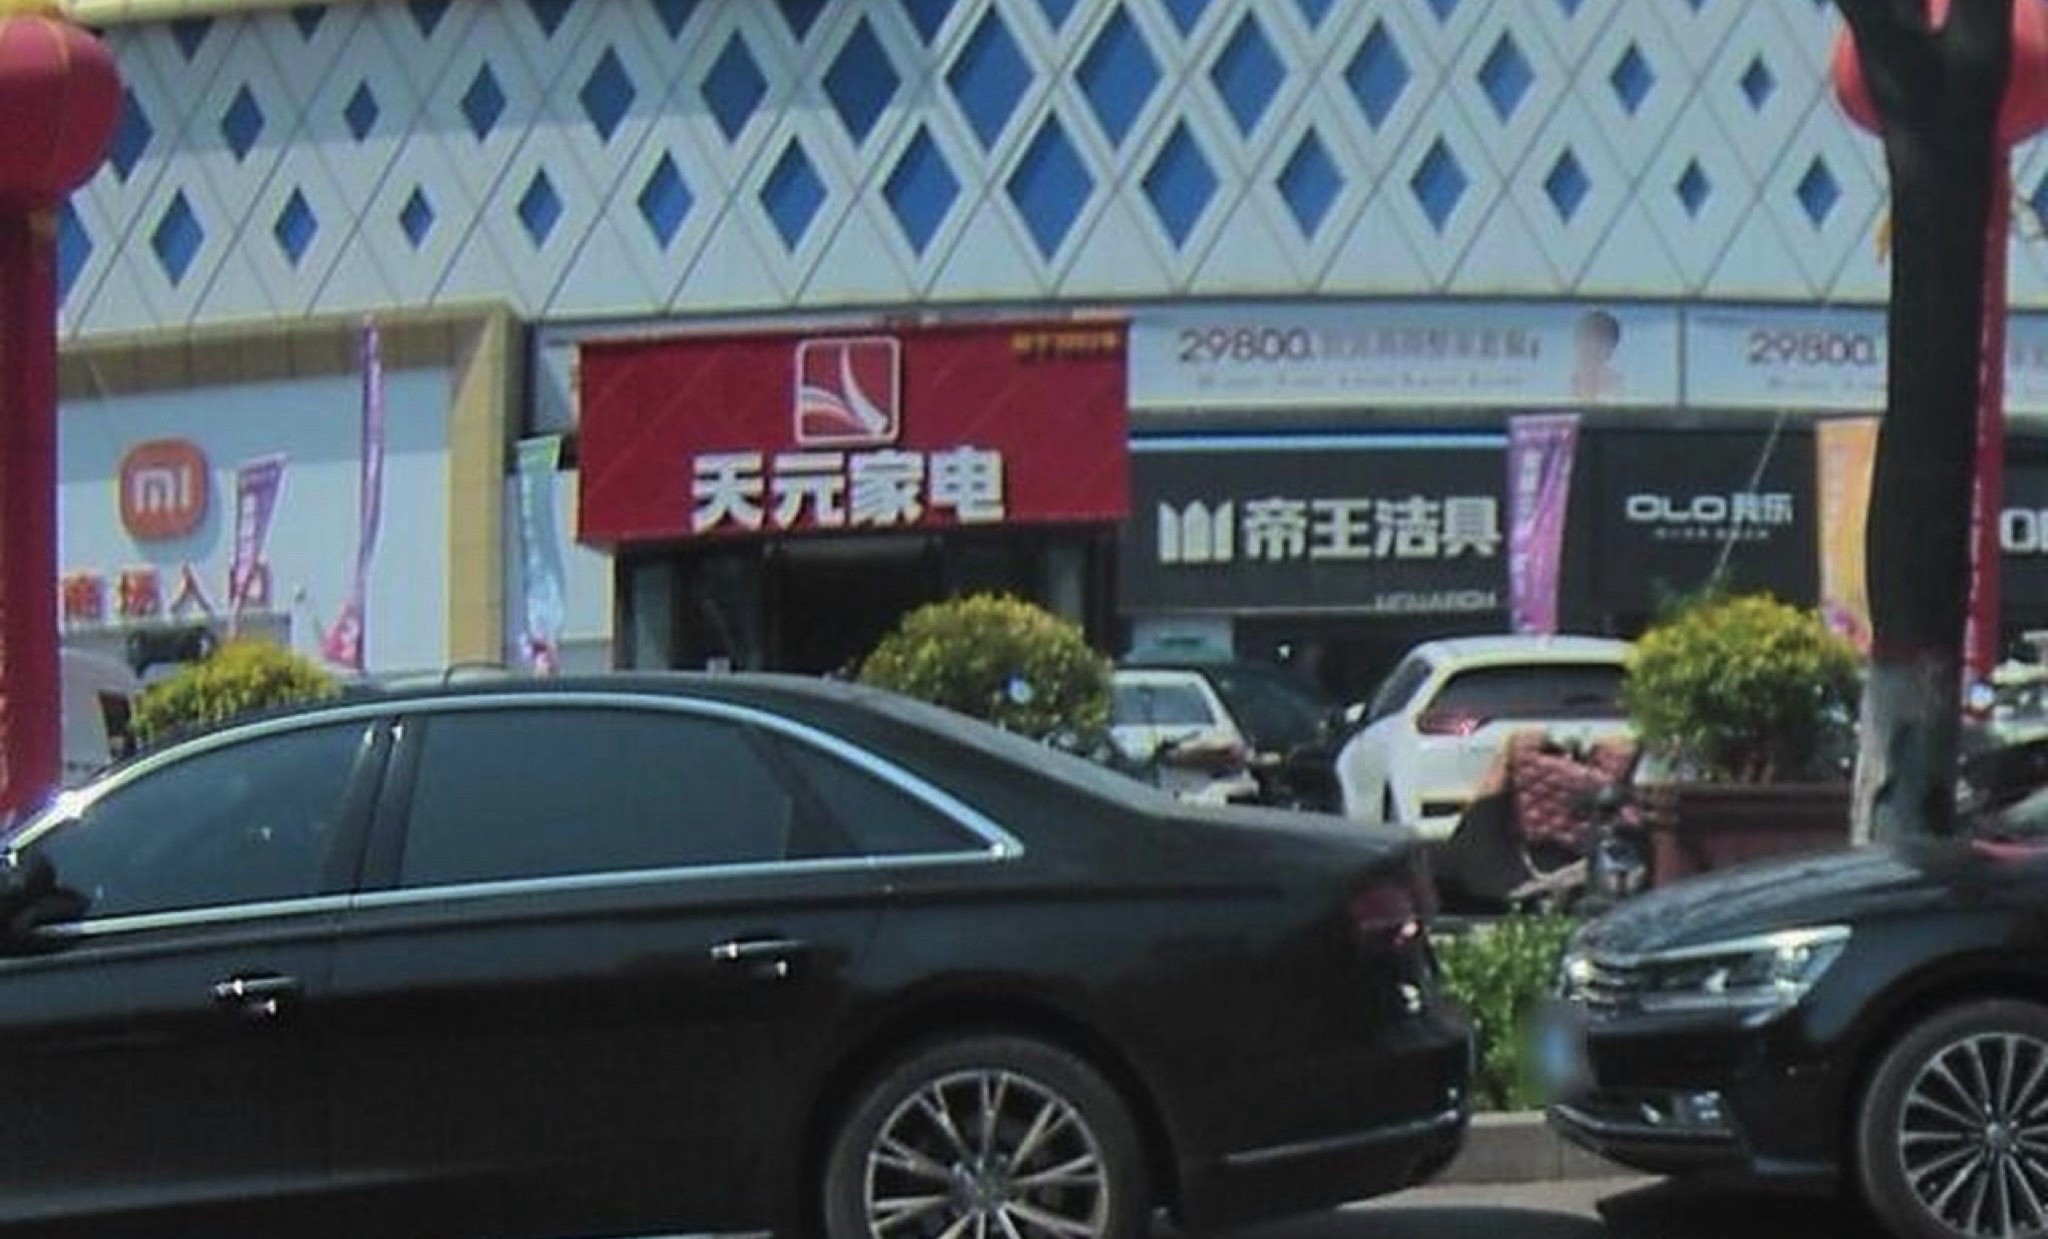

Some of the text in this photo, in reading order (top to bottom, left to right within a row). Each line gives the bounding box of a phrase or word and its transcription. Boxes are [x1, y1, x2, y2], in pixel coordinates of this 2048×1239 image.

[691, 446, 1005, 533] 天元家电
[1244, 495, 1501, 561] 帝王洁具
